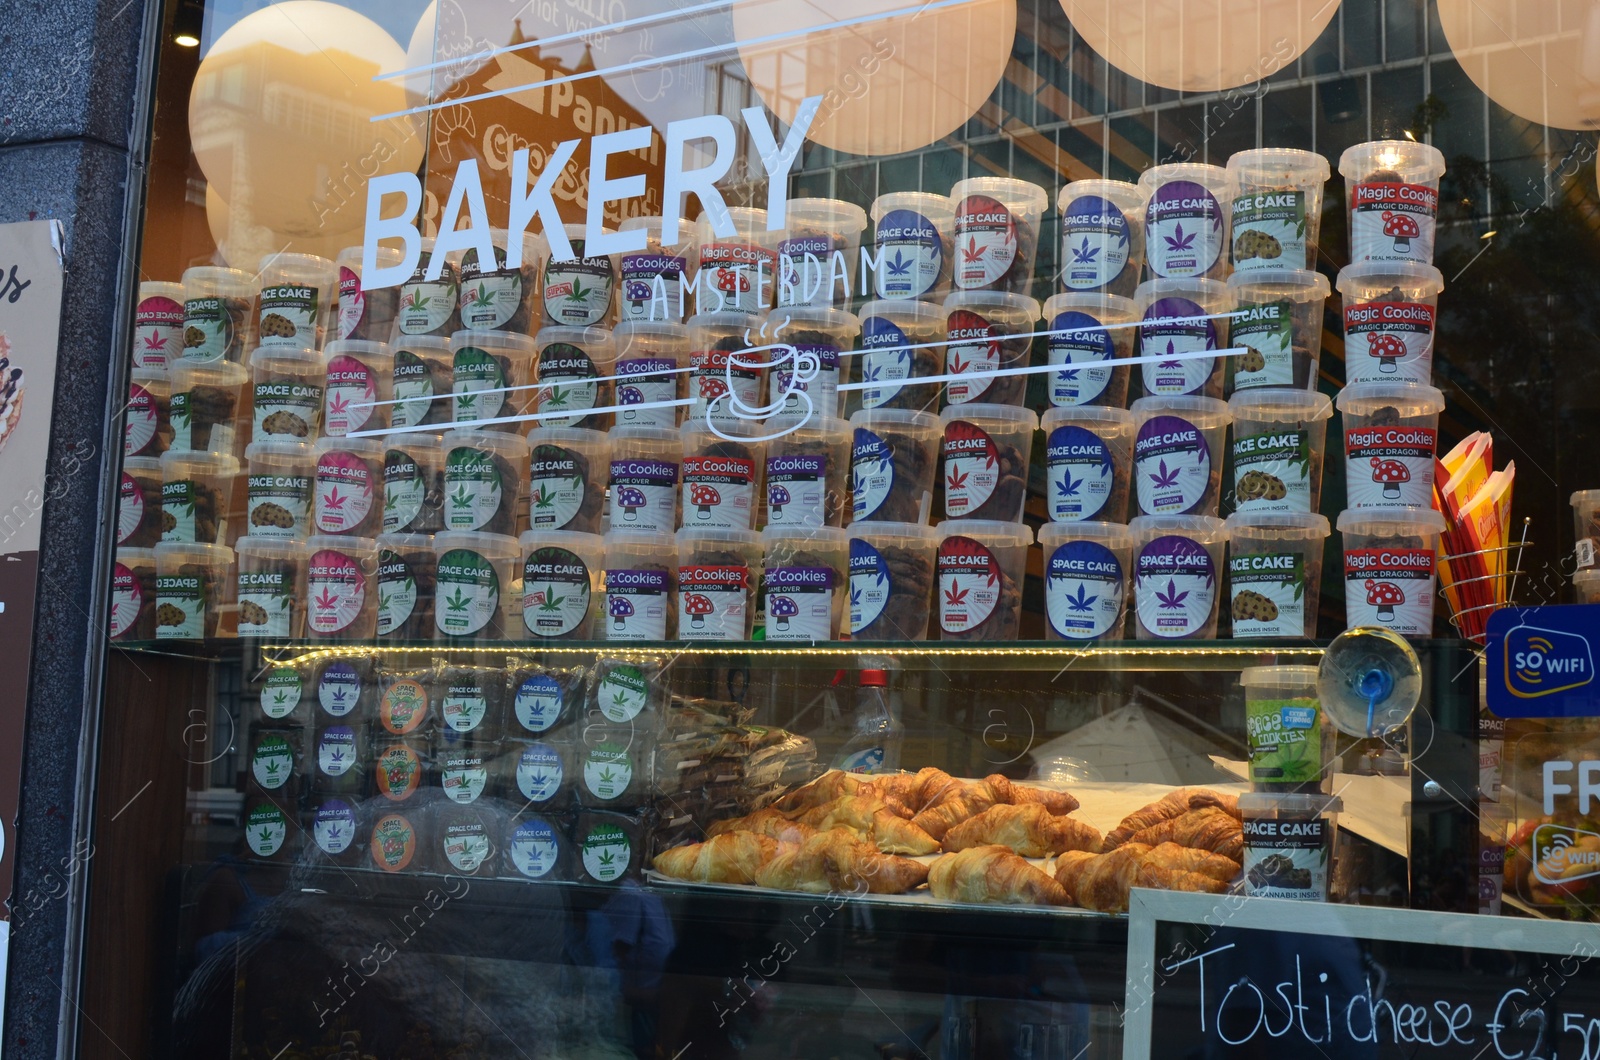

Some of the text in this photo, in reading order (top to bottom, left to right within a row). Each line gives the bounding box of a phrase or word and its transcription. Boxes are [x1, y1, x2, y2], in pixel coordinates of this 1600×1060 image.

[361, 94, 824, 292] BAKERY
[1357, 187, 1396, 201] Magic
[1148, 198, 1214, 215] SPACE CAKE
[1254, 194, 1296, 209] CAKE
[1371, 202, 1428, 214] MAGIC DRAGON
[976, 213, 1007, 224] CAKE
[1064, 215, 1123, 227] SPACE CAKE
[876, 227, 933, 240] SPACE CAKE
[783, 239, 827, 254] Cookies
[581, 256, 609, 269] CAKE
[702, 247, 774, 266] Magic Cookies
[636, 257, 681, 271] Cookies
[1169, 260, 1193, 268] MEDIUM
[339, 278, 356, 290] CAKE
[649, 243, 886, 322] AMSTERDAM
[279, 287, 311, 299] CAKE
[1243, 306, 1280, 321] CAKE
[1347, 305, 1431, 322] Magic Cookies
[1357, 323, 1416, 331] MAGIC DRAGON
[872, 333, 899, 343] CAKE
[959, 328, 989, 339] CAKE
[1049, 332, 1106, 344] SPACE CAKE
[400, 365, 424, 375] CAKE
[468, 363, 495, 373] CAKE
[558, 359, 589, 369] CAKE
[626, 361, 671, 374] Cookies
[341, 371, 367, 381] CAKE
[256, 385, 320, 398] SPACE CAKE
[957, 438, 987, 449] CAKE
[1136, 430, 1197, 453] SPACE CAKE
[1256, 434, 1299, 449] CAKE
[1348, 431, 1434, 446] Magic Cookies
[856, 442, 880, 454] CAKE
[1047, 445, 1102, 458] SPACE CAKE
[1360, 448, 1419, 456] MAGIC DRAGON
[390, 463, 414, 474] CAKE
[464, 464, 493, 474] CAKE
[545, 460, 574, 471] CAKE
[628, 463, 674, 477] Cookies
[701, 460, 749, 474] Cookies
[773, 458, 819, 471] Cookies
[317, 465, 367, 479] SPACE CAKE
[248, 477, 308, 488] SPACE CAKE
[630, 477, 650, 485] OVER
[700, 475, 731, 483] DRAGON
[1156, 496, 1180, 506] MEDIUM
[854, 555, 877, 566] CAKE
[958, 555, 989, 566] CAKE
[1052, 558, 1117, 574] SPACE CAKE
[1140, 555, 1208, 567] SPACE CAKE
[1251, 556, 1294, 570] CAKE
[1346, 552, 1431, 568] Magic Cookies
[308, 567, 356, 576] SPACE CAKE
[382, 563, 406, 574] CAKE
[438, 565, 492, 579] SPACE CAKE
[525, 564, 583, 575] SPACE CAKE
[1355, 570, 1414, 579] MAGIC DRAGON
[250, 573, 282, 585] CAKE
[617, 572, 663, 585] Cookies
[694, 569, 742, 582] Cookies
[778, 570, 827, 583] Cookies
[619, 586, 637, 594] OVER
[782, 585, 801, 593] OVER
[1515, 651, 1585, 674] SO WIFI
[609, 671, 645, 688] SPACE CAKE
[448, 686, 465, 694] SPACE
[521, 684, 558, 693] SPACE CAKE
[1284, 716, 1312, 724] STRONG
[523, 753, 558, 762] SPACE CAKE
[516, 829, 535, 837] SPACE
[1243, 822, 1322, 836] SPACE CAKE
[587, 832, 624, 842] SPACE CAKE
[1542, 846, 1565, 861] SO
[1299, 891, 1321, 899] INSIDE
[1347, 976, 1475, 1047] cheese
